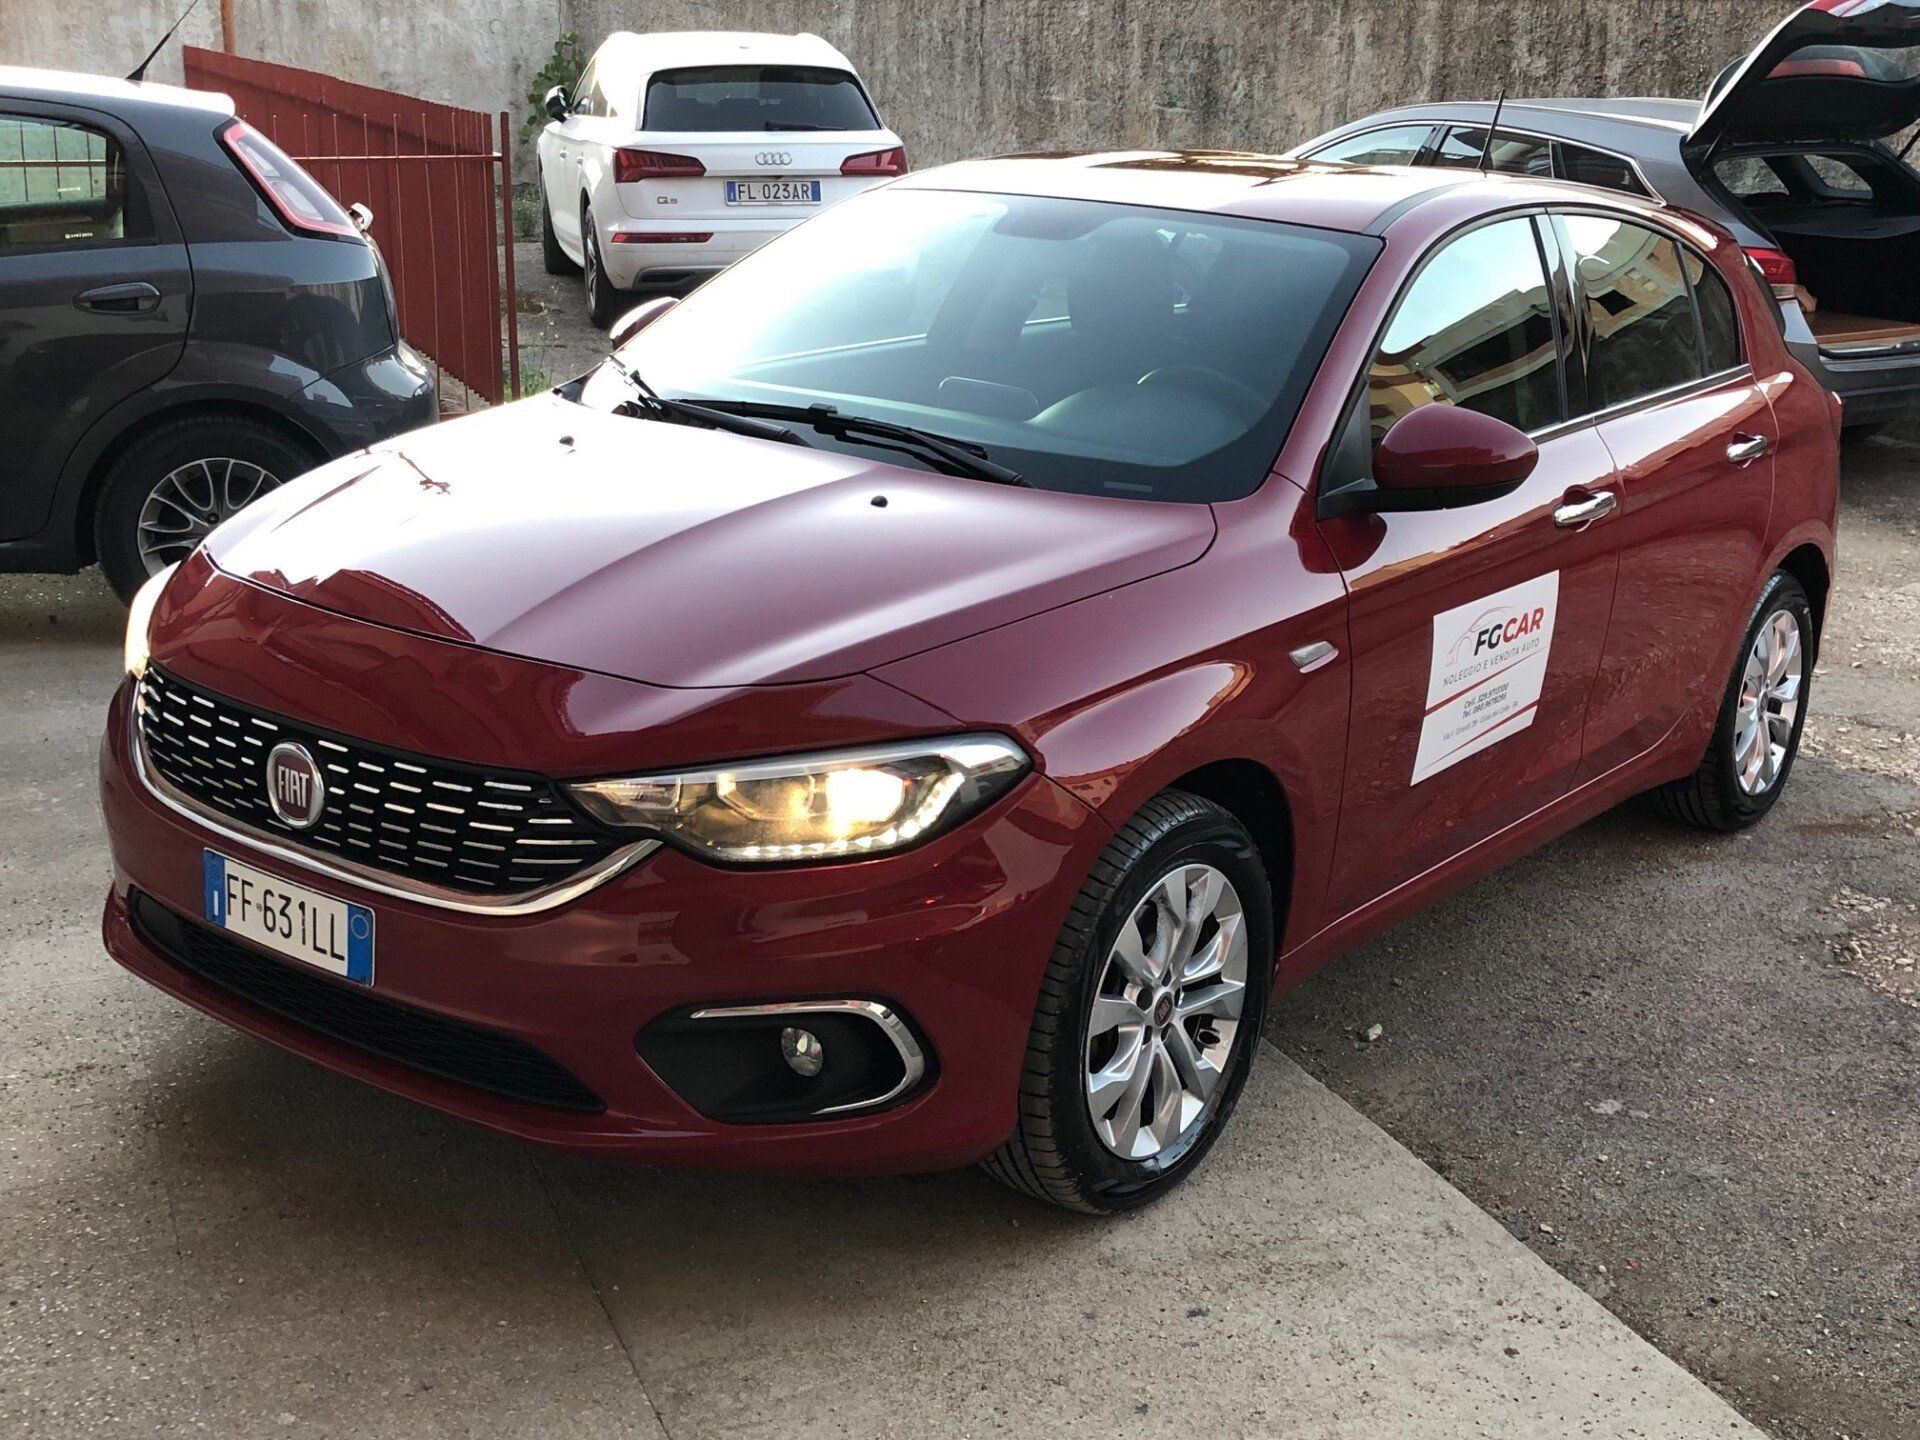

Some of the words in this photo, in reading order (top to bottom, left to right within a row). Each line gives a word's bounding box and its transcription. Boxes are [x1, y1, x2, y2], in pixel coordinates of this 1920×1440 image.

[657, 196, 678, 205] Q5
[1474, 607, 1544, 656] FGCAR
[1443, 662, 1481, 687] NOLEGGIO
[1483, 660, 1489, 670] E
[1490, 647, 1519, 666] VENDITA
[1521, 638, 1540, 653] AUTO
[278, 765, 310, 808] FIAT
